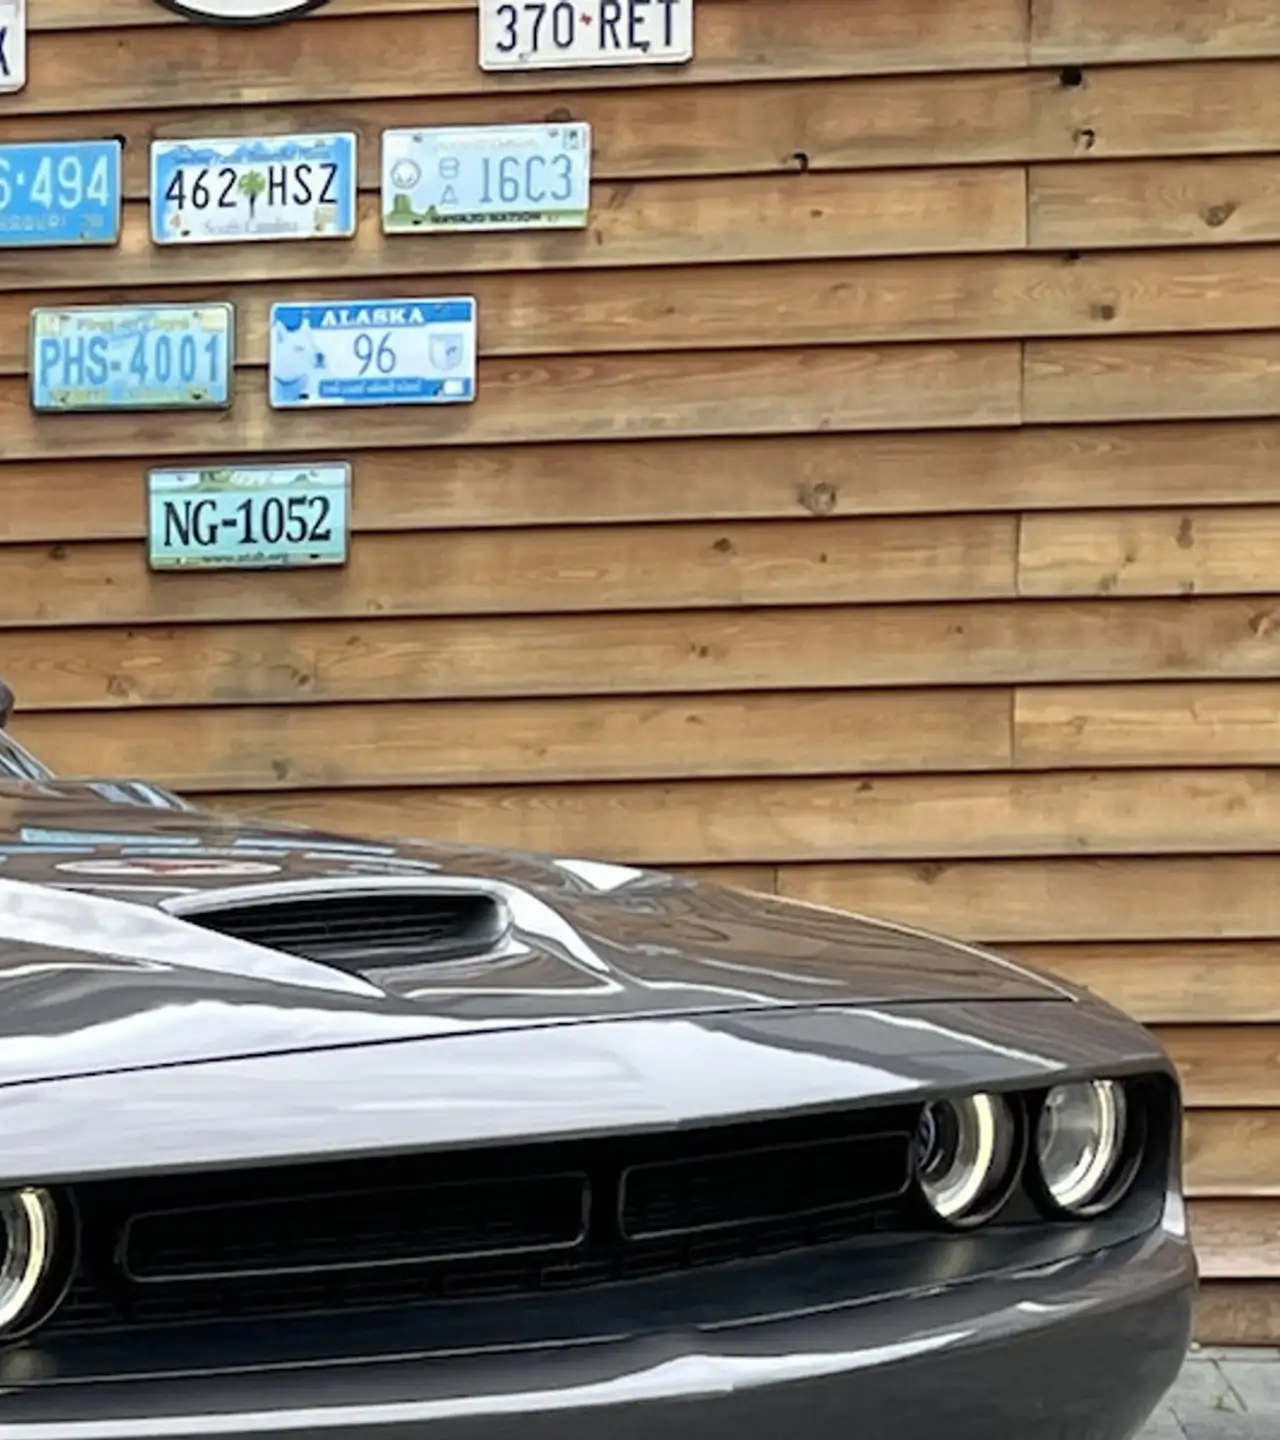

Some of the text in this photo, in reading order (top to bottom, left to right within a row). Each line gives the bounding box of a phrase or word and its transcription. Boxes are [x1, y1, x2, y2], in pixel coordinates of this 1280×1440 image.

[495, 0, 678, 53] 370 RET
[165, 163, 338, 210] 462 HSZ
[321, 308, 424, 327] ALASKA
[40, 334, 219, 386] PHS-4001
[353, 332, 397, 376] 96
[164, 496, 332, 547] NG-1052
